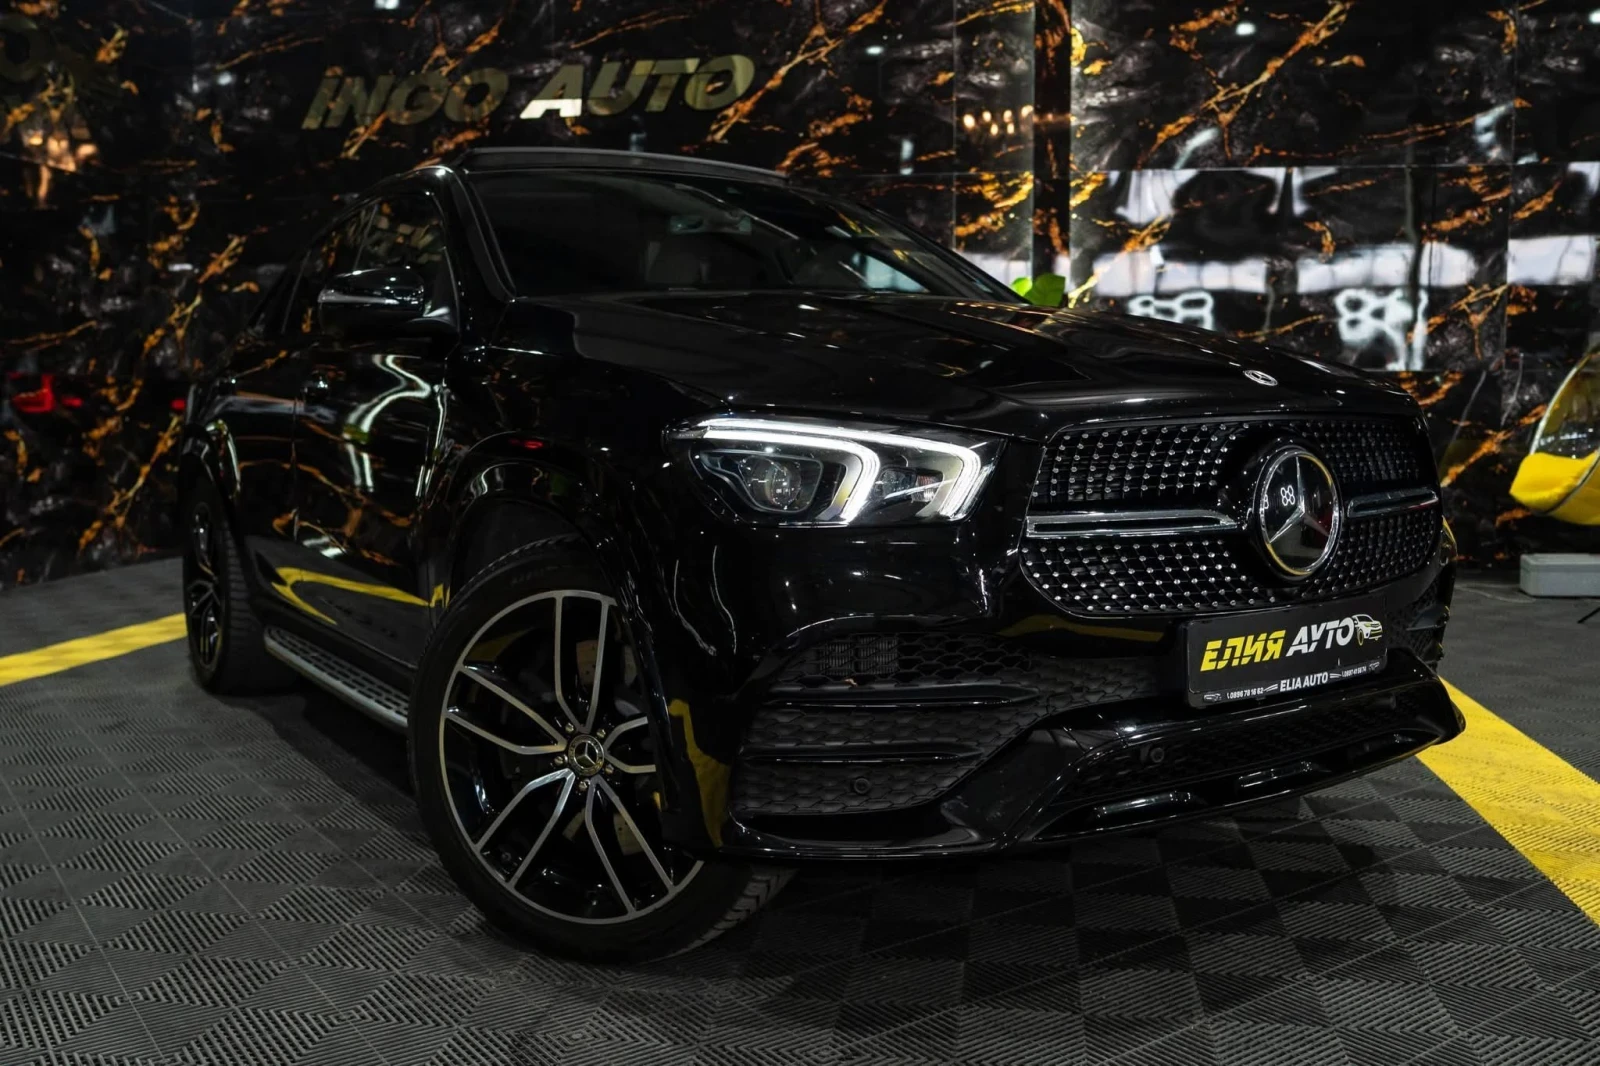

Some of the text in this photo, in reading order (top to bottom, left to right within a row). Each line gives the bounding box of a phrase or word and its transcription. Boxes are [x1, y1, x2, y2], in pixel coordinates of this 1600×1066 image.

[300, 54, 756, 130] INGO AUTO
[1200, 629, 1286, 672] ЕЛИЯ
[1279, 671, 1329, 692] ELIA AUTO
